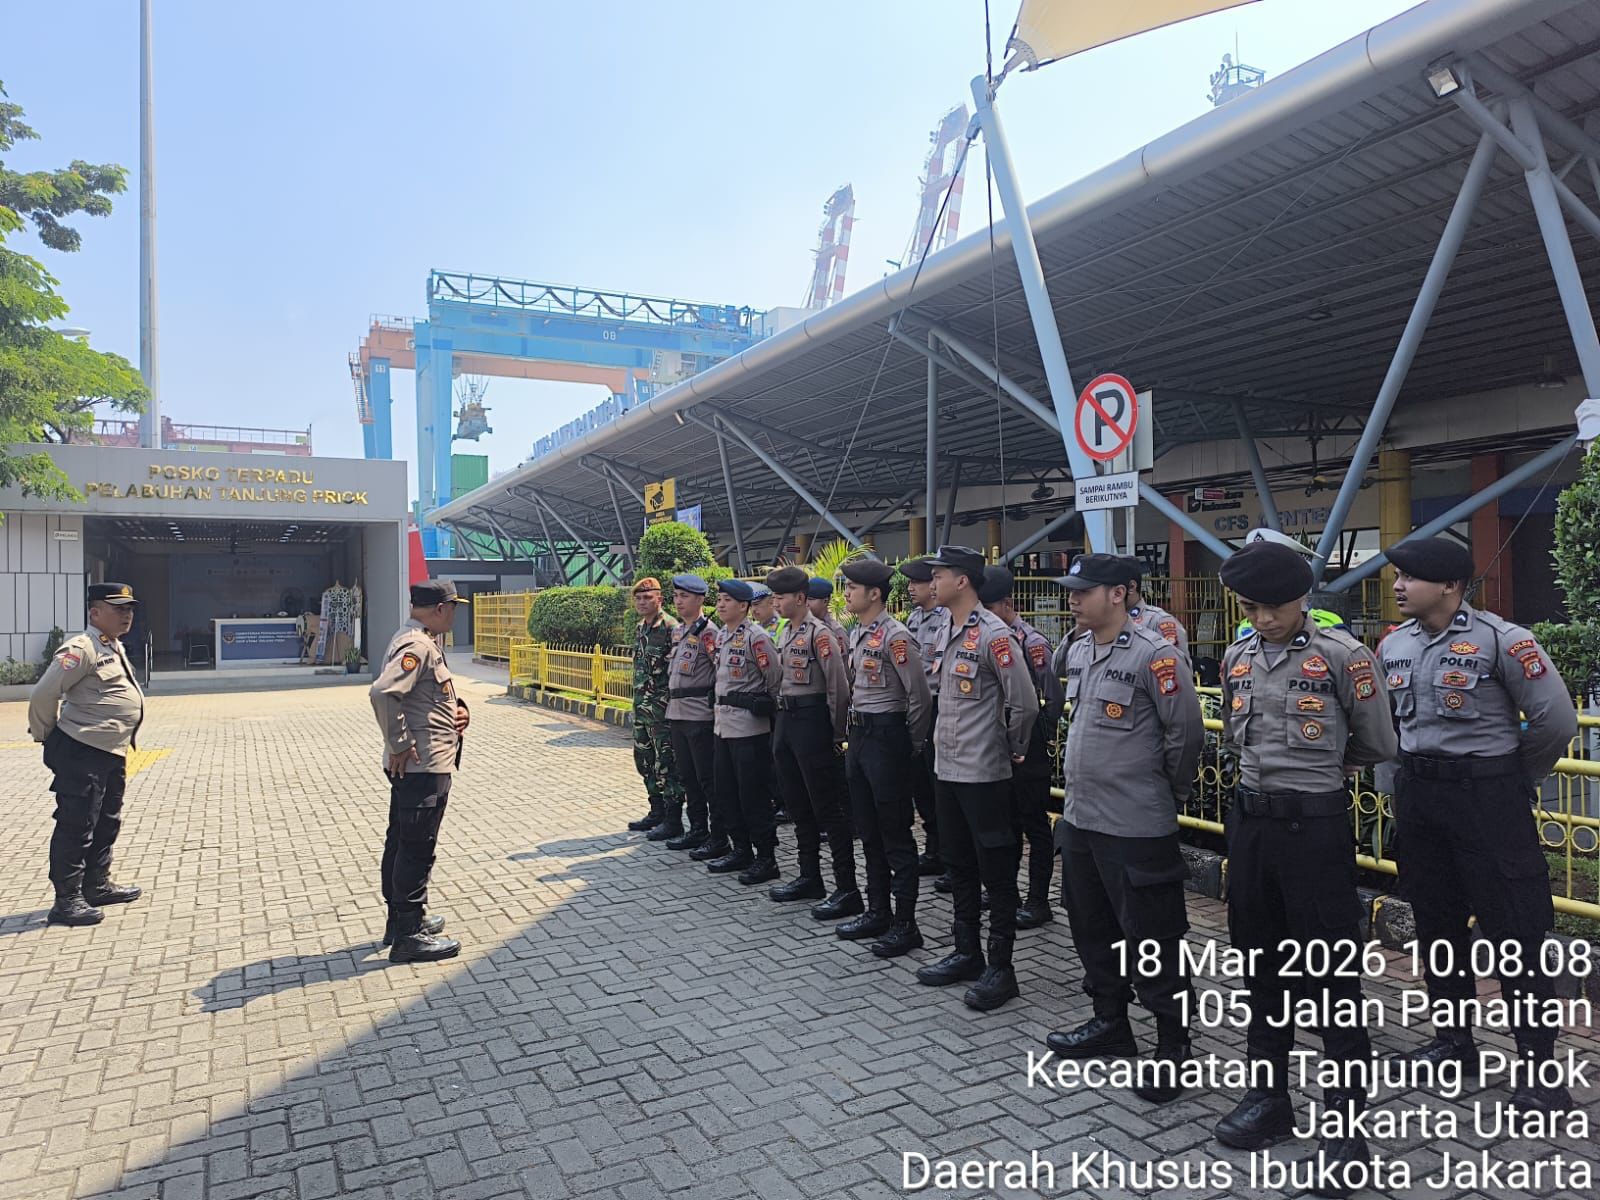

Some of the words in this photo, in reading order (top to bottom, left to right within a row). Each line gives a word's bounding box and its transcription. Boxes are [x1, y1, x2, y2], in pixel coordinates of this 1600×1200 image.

[148, 464, 220, 481] POSKO
[226, 467, 314, 484] TERPADU
[85, 482, 212, 500] PELABUHAN
[217, 487, 308, 502] TANJUNG
[312, 489, 368, 505] PRIOK
[1080, 484, 1106, 495] SAMPAI
[1106, 480, 1133, 491] RAMBU
[1085, 491, 1128, 504] BERIKUTNYA
[1214, 515, 1249, 531] CFS
[790, 647, 808, 656] POLRI
[862, 648, 881, 658] POLRI
[956, 651, 979, 661] POLRI
[1439, 656, 1478, 669] POLRI
[1105, 669, 1136, 684] POLRI
[1288, 679, 1335, 693] POLRI
